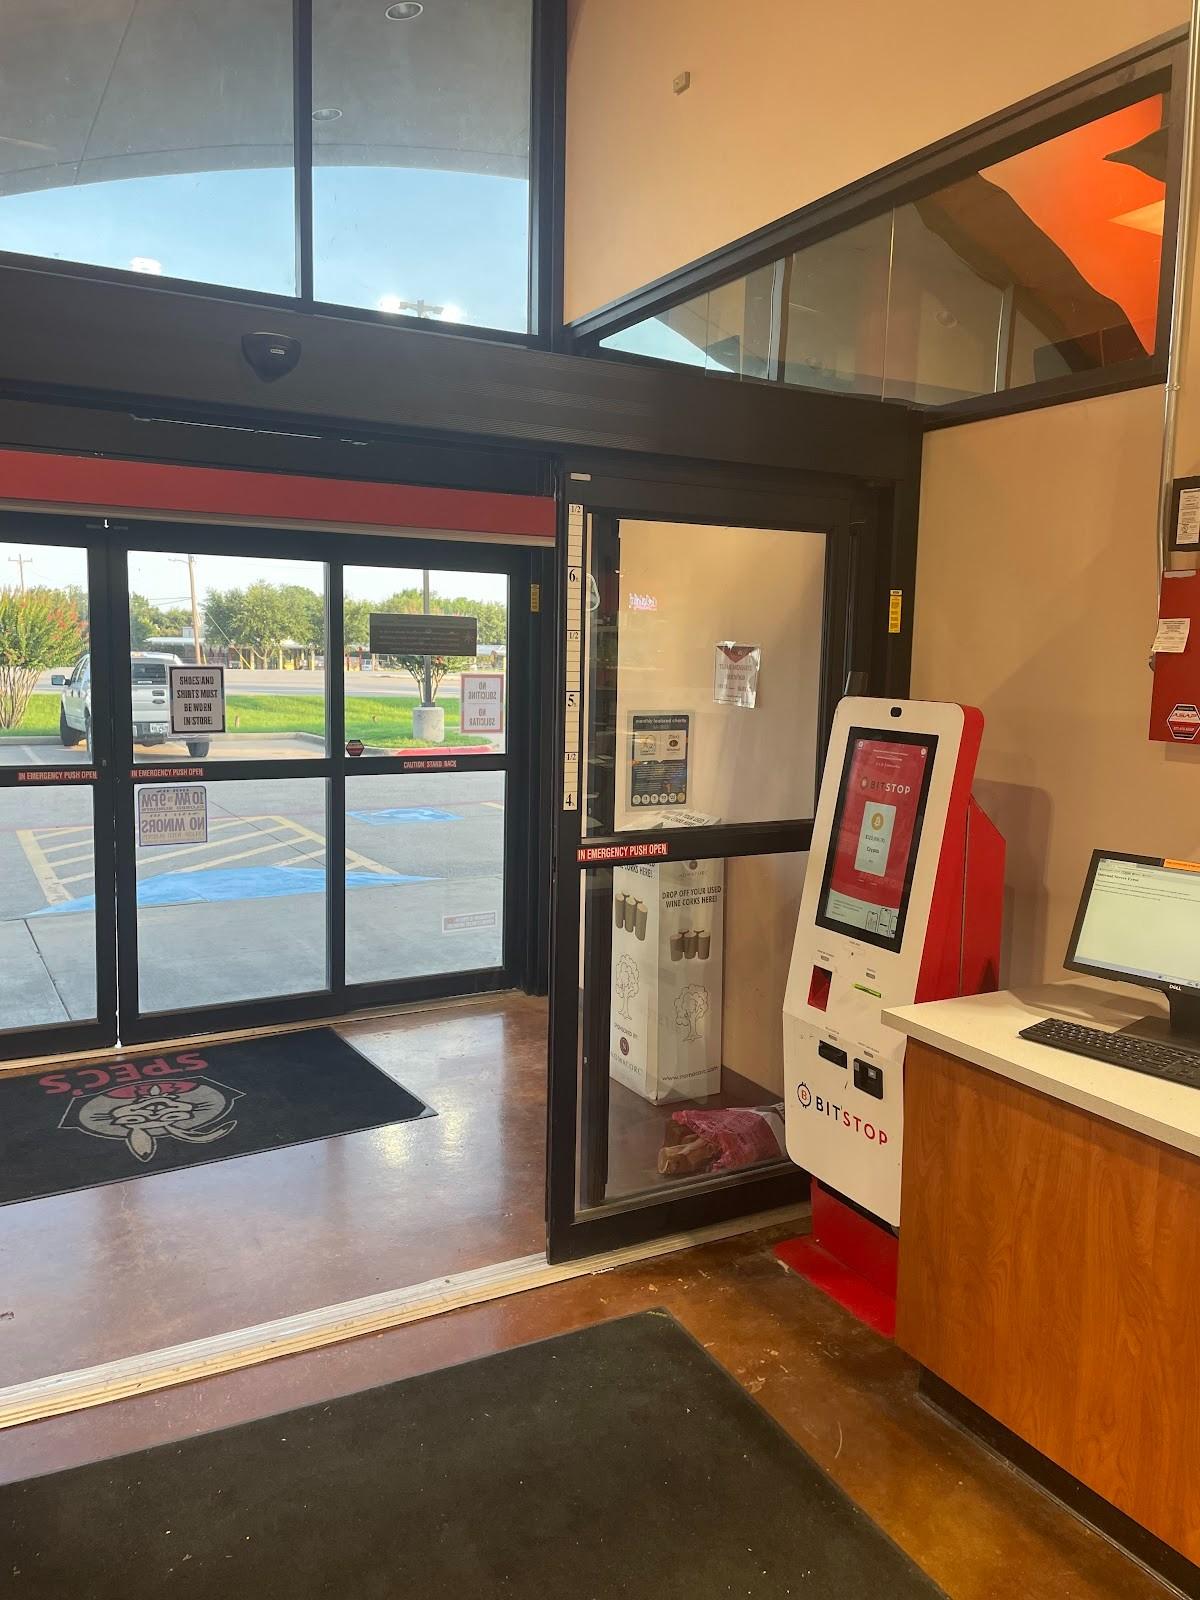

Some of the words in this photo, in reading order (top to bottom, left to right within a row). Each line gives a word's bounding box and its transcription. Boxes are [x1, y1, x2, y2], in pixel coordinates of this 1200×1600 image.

[571, 505, 581, 513] 1/2
[569, 569, 576, 582] 6
[569, 631, 579, 639] 1/2
[179, 676, 200, 685] SHOES
[201, 676, 214, 685] AND
[177, 689, 200, 698] SHIRTS
[201, 689, 218, 698] MUST
[567, 693, 575, 707] 5
[184, 703, 192, 712] BE
[193, 702, 212, 711] WORN
[183, 717, 190, 725] IN
[566, 752, 577, 761] 1/2
[403, 761, 425, 769] CAUTION
[426, 760, 442, 768] STAND
[18, 772, 26, 781] IN
[27, 771, 63, 780] EMERGENCY
[64, 771, 80, 780] PUSH
[81, 770, 98, 779] OPEN
[131, 769, 138, 777] IN
[139, 769, 172, 777] EMERGENCY
[172, 768, 188, 776] PUSH
[189, 767, 204, 776] OPEN
[577, 849, 586, 860] IN
[587, 845, 629, 860] EMERGENCY
[629, 844, 648, 856] PUSH
[648, 842, 668, 855] OPEN
[662, 890, 678, 900] DROP
[679, 889, 690, 898] OFF
[690, 887, 706, 896] YOUR
[707, 885, 722, 895] USED
[665, 899, 681, 909] WINE
[682, 897, 700, 906] CORKS
[38, 1053, 208, 1097] SPEC'S
[816, 1095, 889, 1146] BITSTOP
